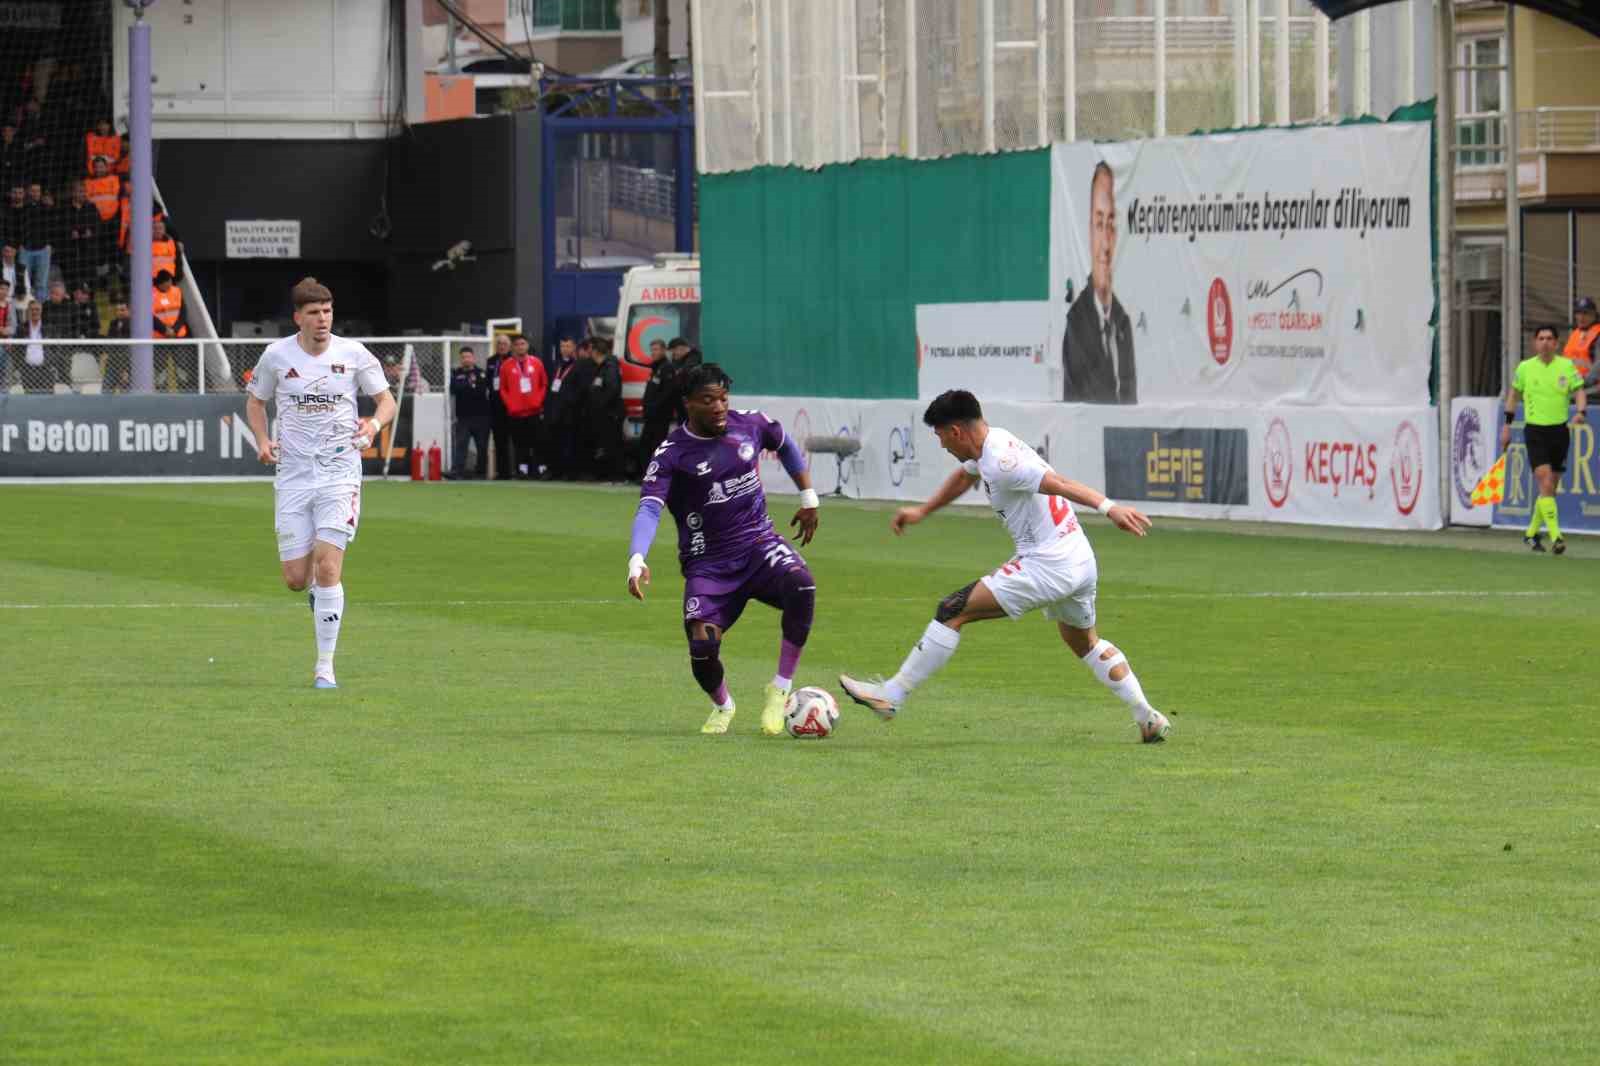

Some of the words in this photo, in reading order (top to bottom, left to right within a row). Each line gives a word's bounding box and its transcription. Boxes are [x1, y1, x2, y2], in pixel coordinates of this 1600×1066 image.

[1128, 194, 1260, 242] Keçiörengücümüze
[1262, 189, 1330, 239] başarılar
[1333, 187, 1411, 239] diliyorum
[27, 420, 109, 453] Beton
[118, 419, 205, 454] Enerji
[1304, 441, 1378, 500] KEÇTAŞ
